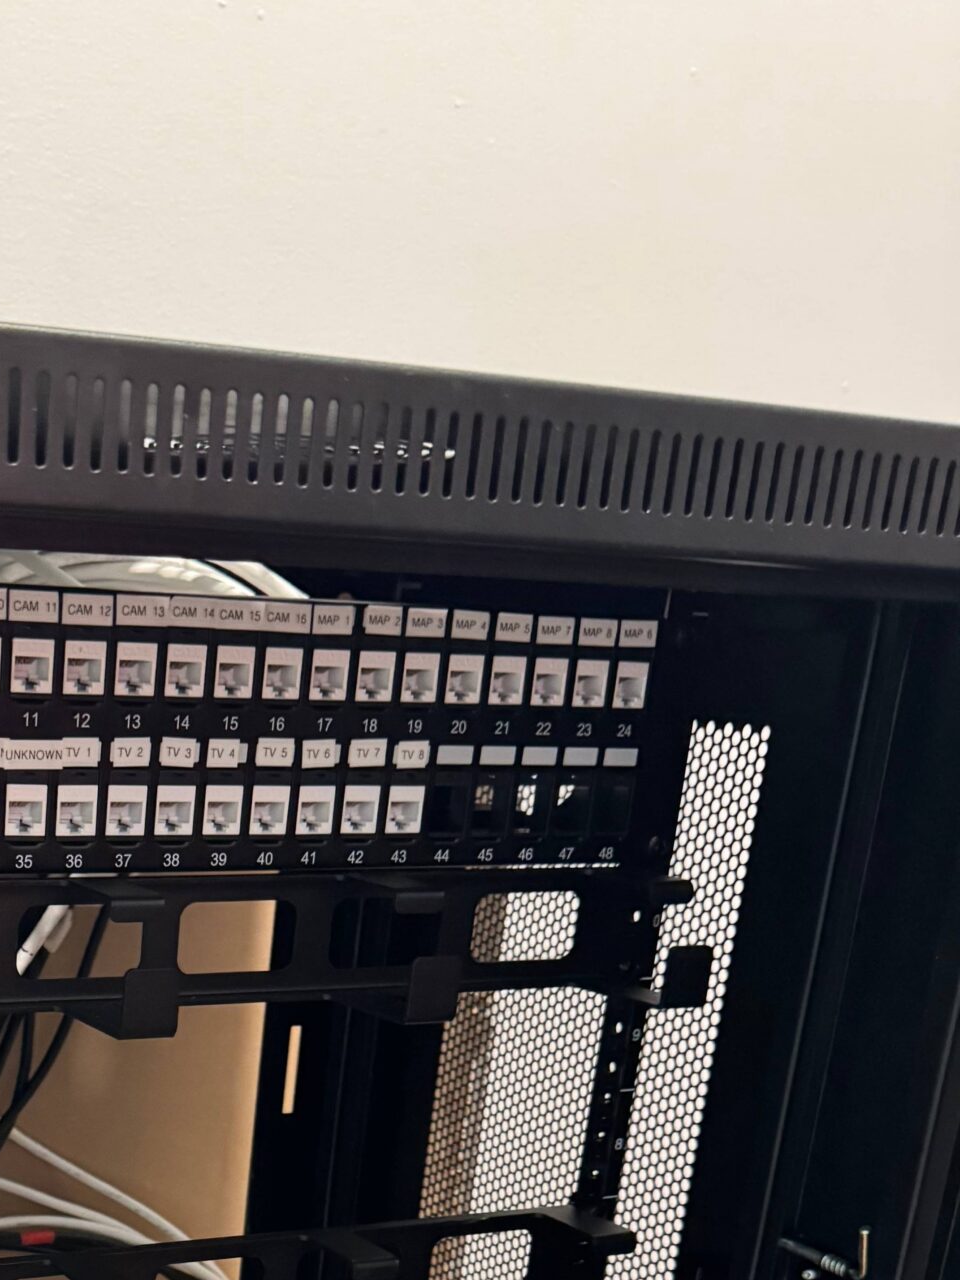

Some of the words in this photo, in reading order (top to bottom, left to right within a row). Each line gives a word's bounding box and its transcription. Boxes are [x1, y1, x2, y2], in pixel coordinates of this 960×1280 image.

[67, 603, 93, 616] CAM
[99, 605, 111, 617] 12
[122, 605, 147, 617] CAM
[153, 606, 165, 617] 13
[369, 614, 390, 625] MAP
[394, 616, 401, 627] 2
[456, 619, 477, 630] MAP
[481, 620, 487, 631] 4
[500, 622, 521, 633] MAP
[524, 623, 530, 634] 5
[541, 624, 562, 635] MAP
[566, 625, 571, 636] 7
[23, 712, 39, 727] 11
[73, 713, 91, 728] 12
[124, 714, 141, 729] 13
[173, 715, 190, 730] 14
[222, 716, 239, 730] 15
[269, 717, 285, 732] 16
[317, 718, 333, 732] 17
[362, 718, 378, 733] 18
[407, 719, 423, 734] 19
[451, 720, 467, 735] 20
[495, 721, 510, 735] 21
[536, 722, 552, 736] 22
[576, 722, 592, 737] 23
[617, 724, 632, 737] 24
[5, 747, 63, 760] UNKNOWN
[118, 747, 132, 757] TV
[137, 747, 143, 757] 2
[211, 748, 224, 758] TV
[228, 748, 235, 757] 4
[263, 747, 276, 758] TV
[281, 748, 287, 758] 5
[356, 748, 370, 758] TV
[374, 748, 380, 758] 7
[163, 853, 180, 867] 38
[210, 853, 227, 867] 39
[257, 852, 274, 865] 40
[300, 851, 317, 865] 41
[347, 851, 365, 864] 42
[390, 850, 407, 863] 43
[434, 849, 450, 863] 44
[598, 847, 614, 860] 48
[15, 855, 33, 869] 35
[65, 854, 83, 868] 36
[114, 854, 132, 868] 37
